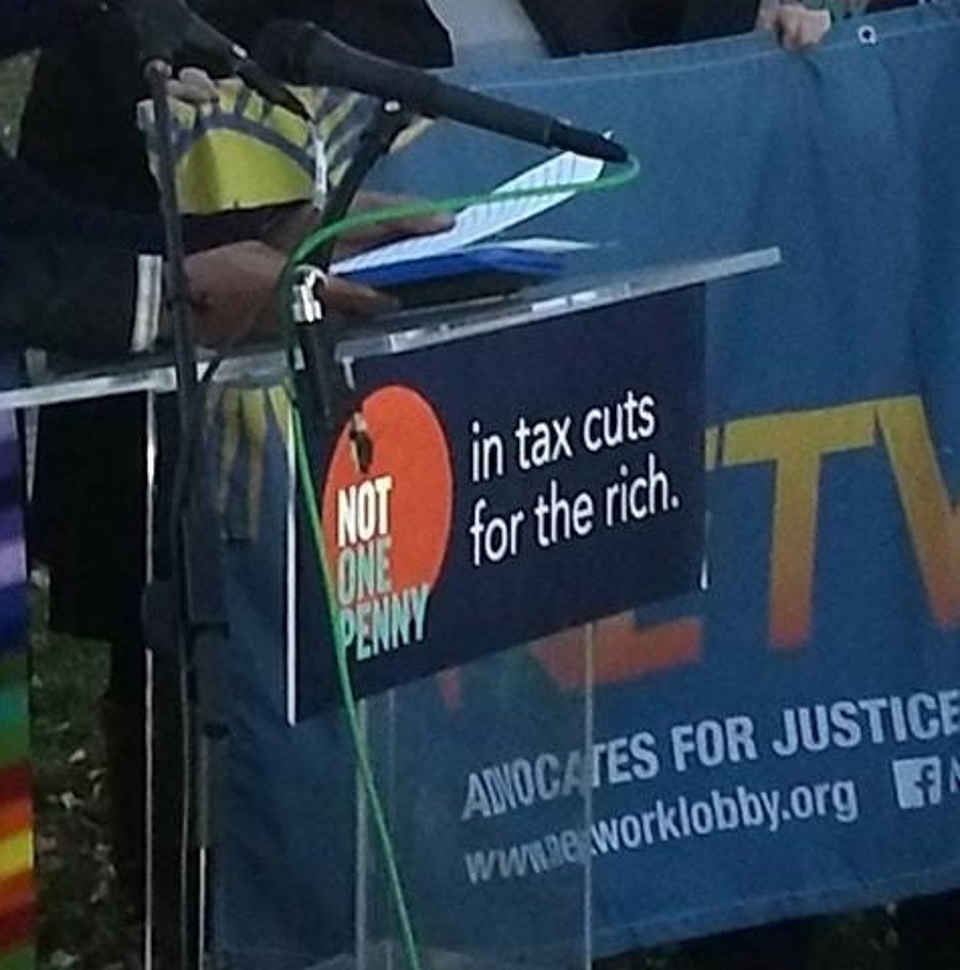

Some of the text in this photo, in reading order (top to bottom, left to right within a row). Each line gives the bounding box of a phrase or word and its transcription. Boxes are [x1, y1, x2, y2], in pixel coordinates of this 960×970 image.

[472, 390, 656, 483] in tax cuts
[338, 453, 681, 567] NOT for the rich.
[338, 535, 392, 608] ONE
[340, 582, 431, 662] PENNY
[671, 715, 759, 774] FOR
[772, 690, 960, 758] JUSTICE
